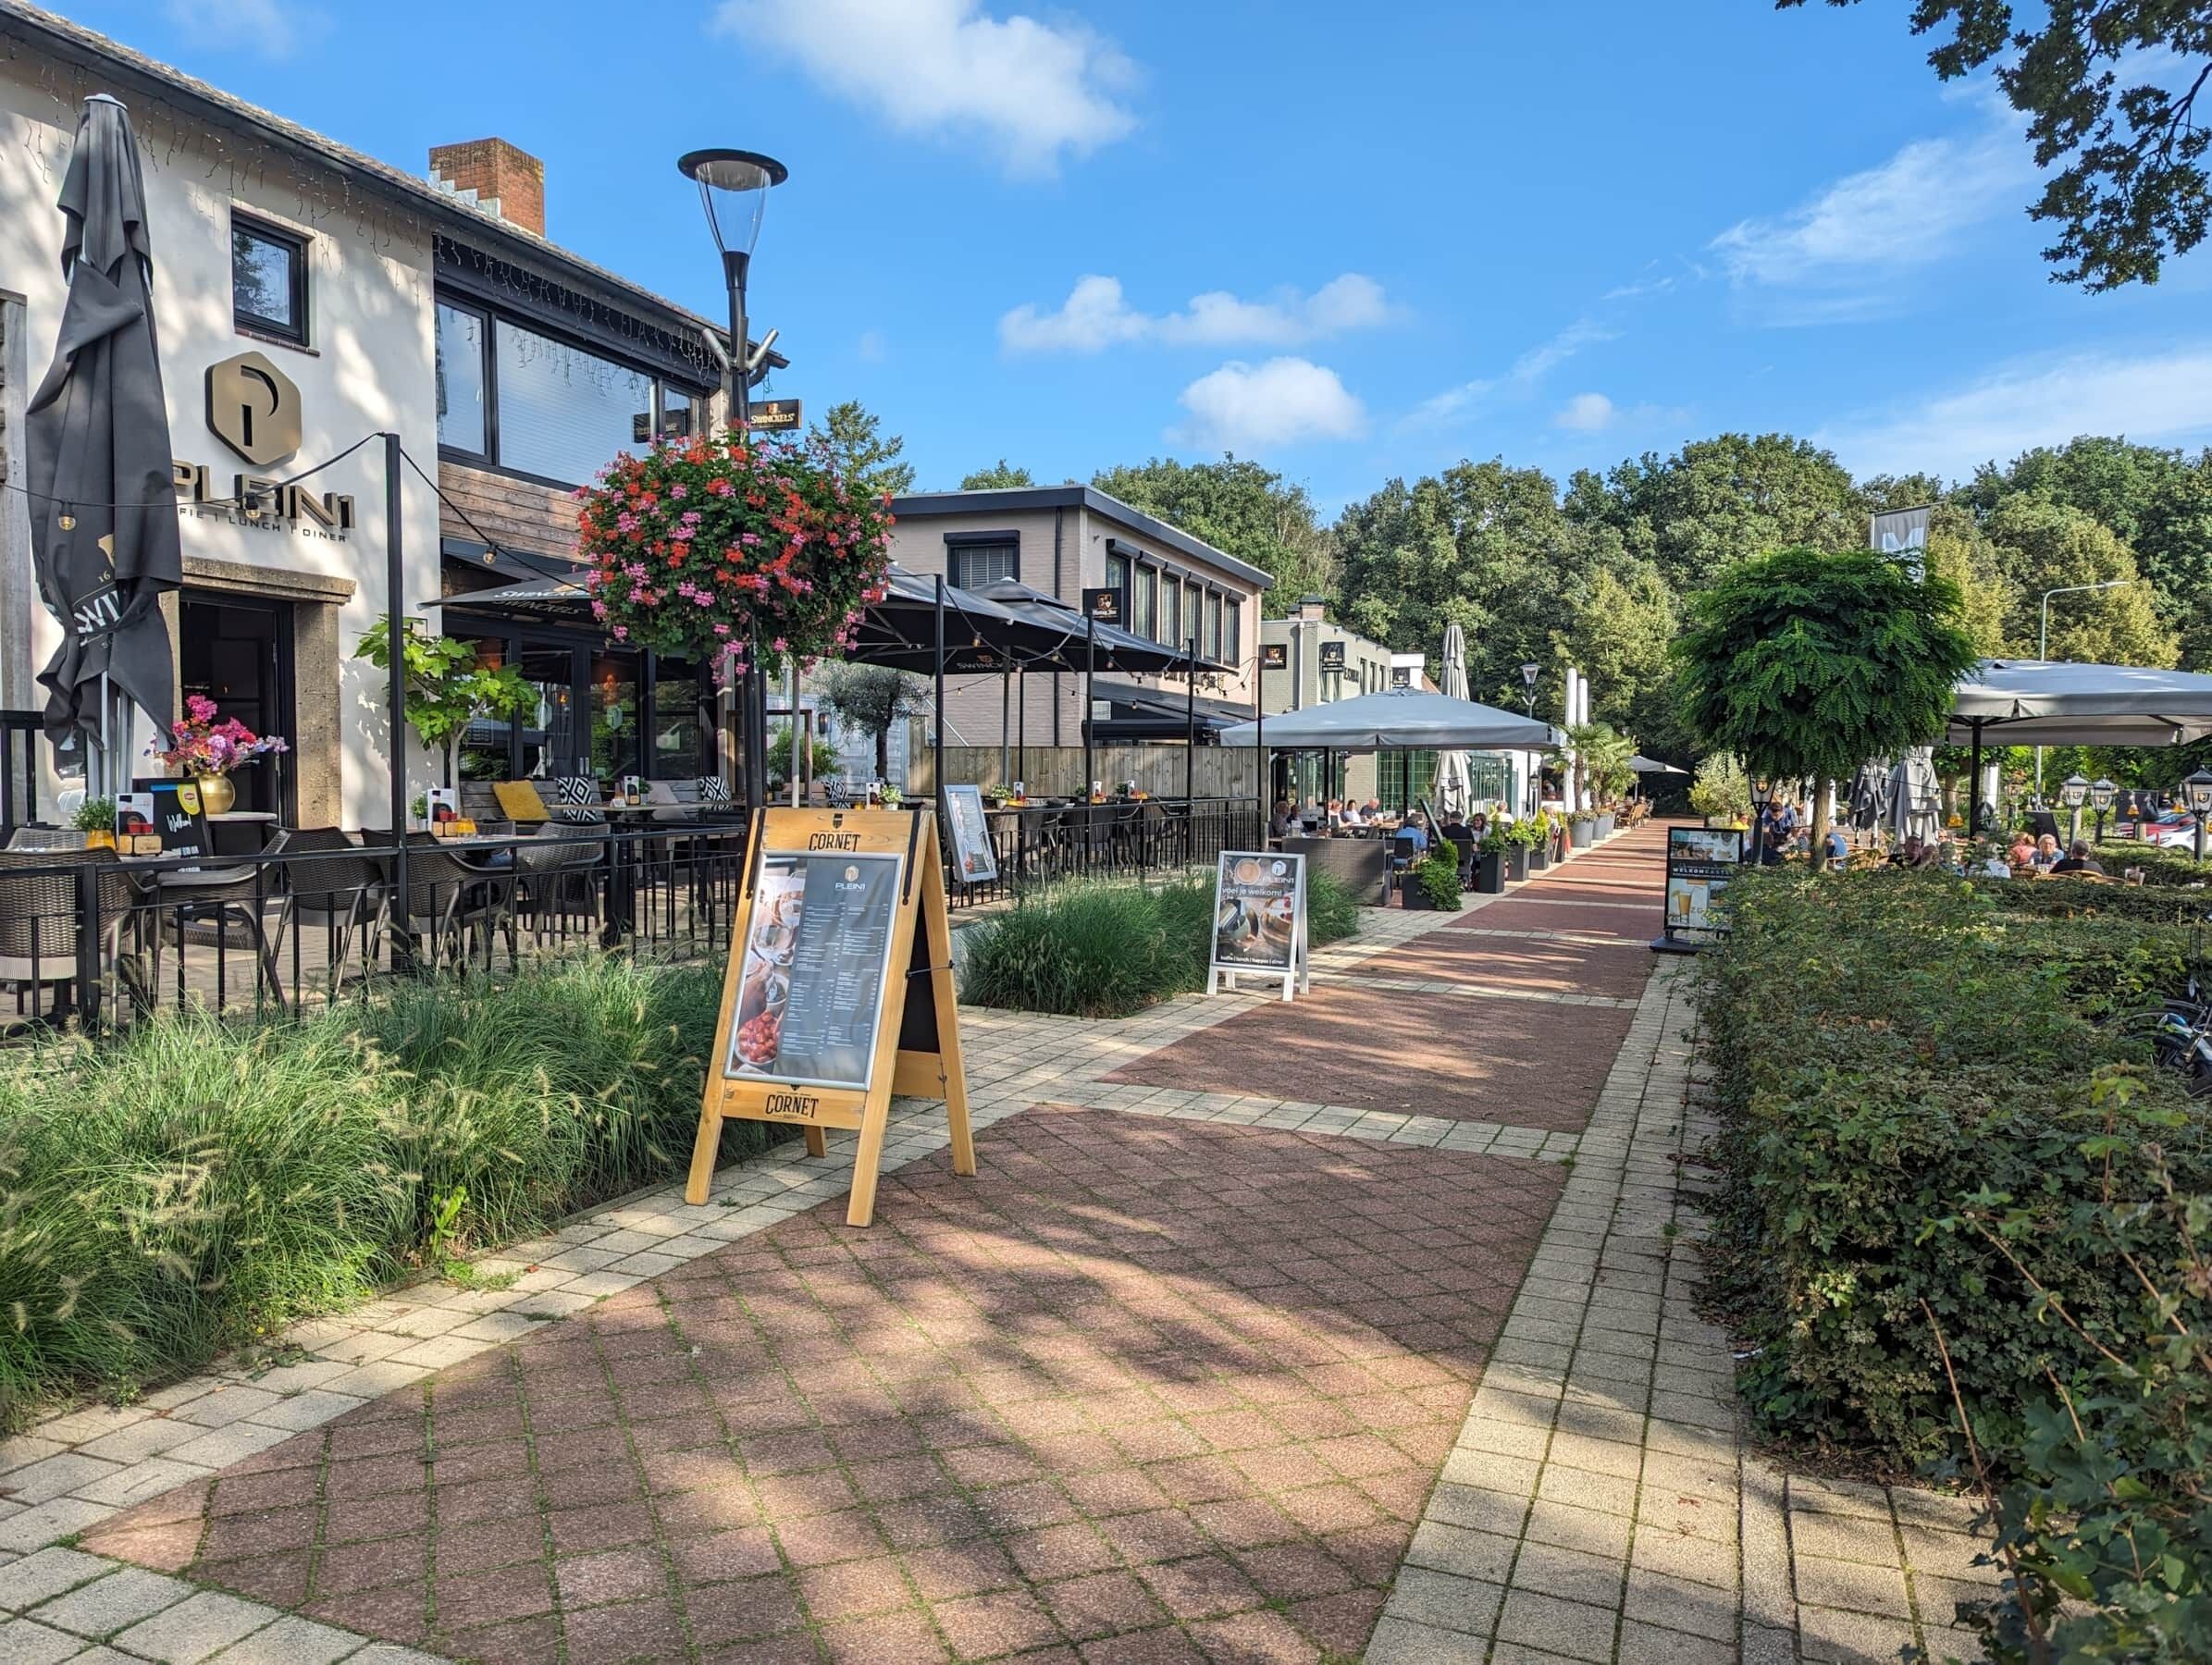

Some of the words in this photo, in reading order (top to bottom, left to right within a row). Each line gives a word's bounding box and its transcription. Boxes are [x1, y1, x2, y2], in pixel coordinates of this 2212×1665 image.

[229, 515, 281, 532] LUNCH
[303, 528, 347, 542] DINER
[809, 832, 861, 852] CORNET
[1239, 887, 1246, 896] je
[1248, 888, 1282, 896] welkom!
[765, 1094, 820, 1118] CORNET
